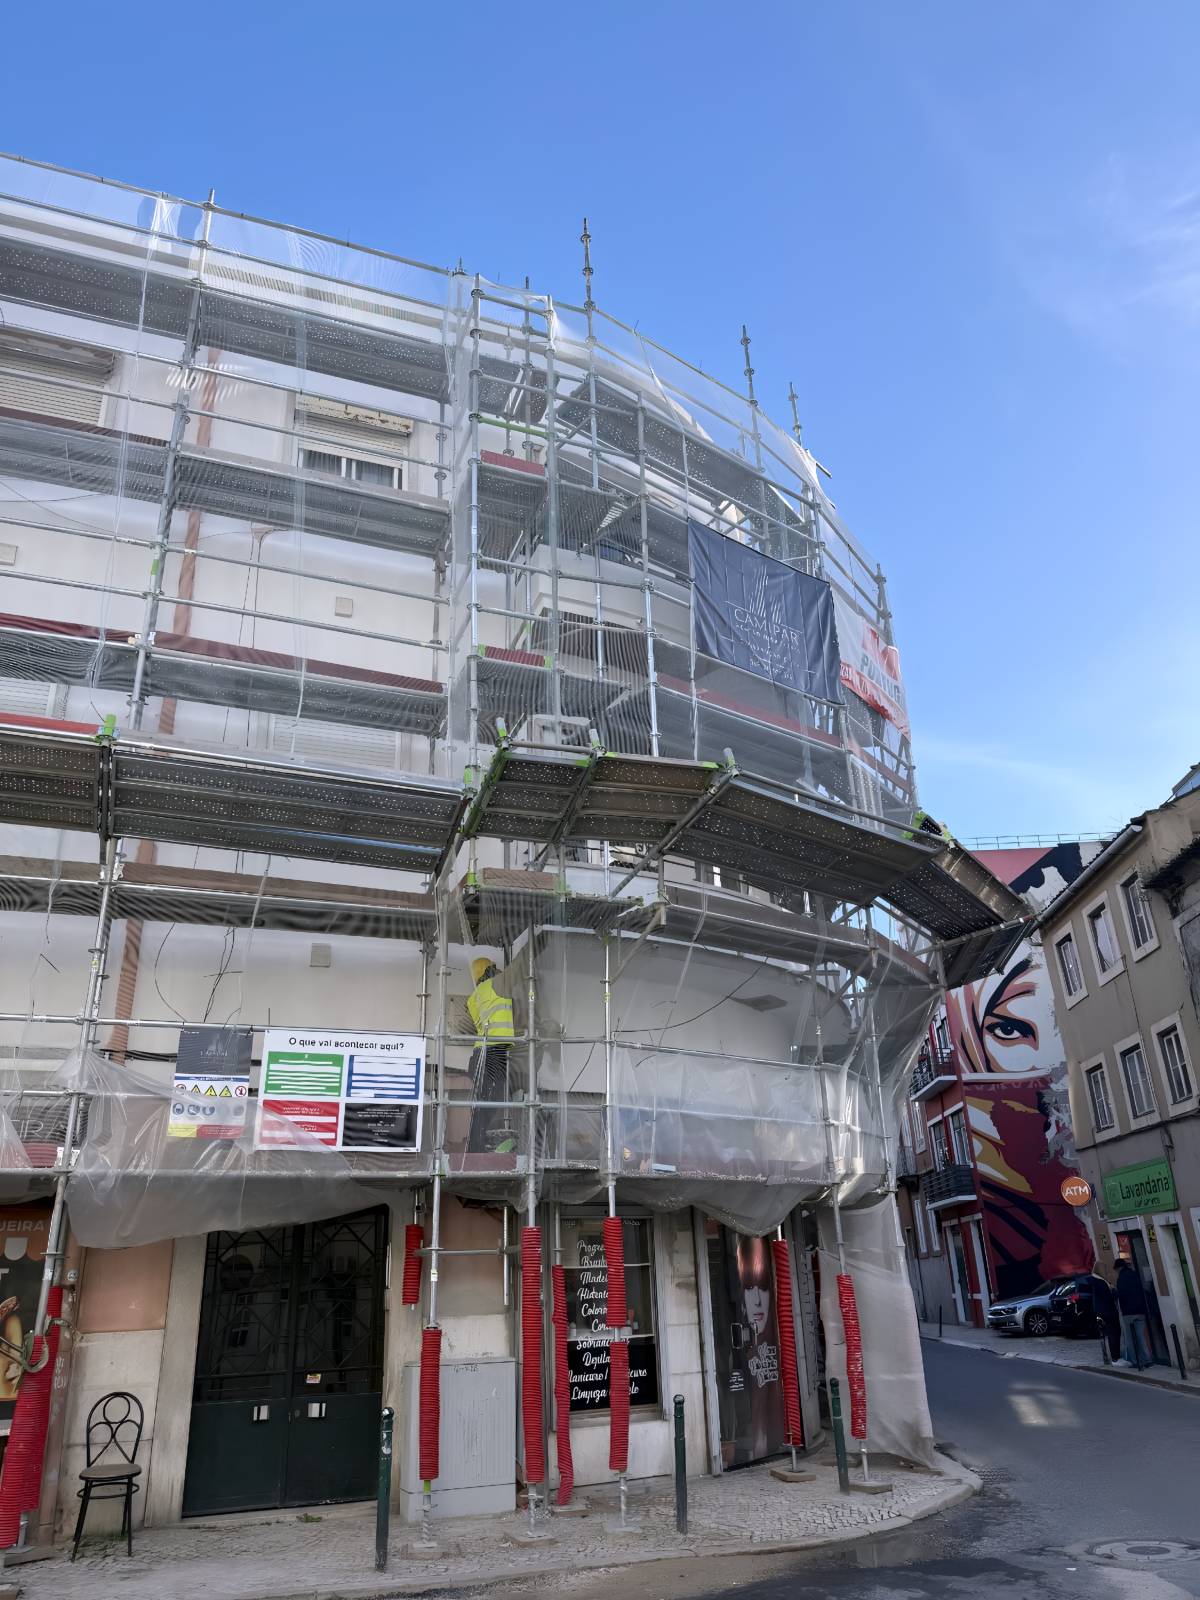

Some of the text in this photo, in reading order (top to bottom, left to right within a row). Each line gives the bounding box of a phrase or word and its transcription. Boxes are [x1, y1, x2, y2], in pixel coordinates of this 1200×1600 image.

[289, 1037, 404, 1051] O que vai acontecer aqui?
[1064, 1185, 1089, 1197] ATM
[1119, 1171, 1170, 1200] Lavandaria
[580, 1270, 609, 1285] Madei
[583, 1351, 611, 1370] Depila
